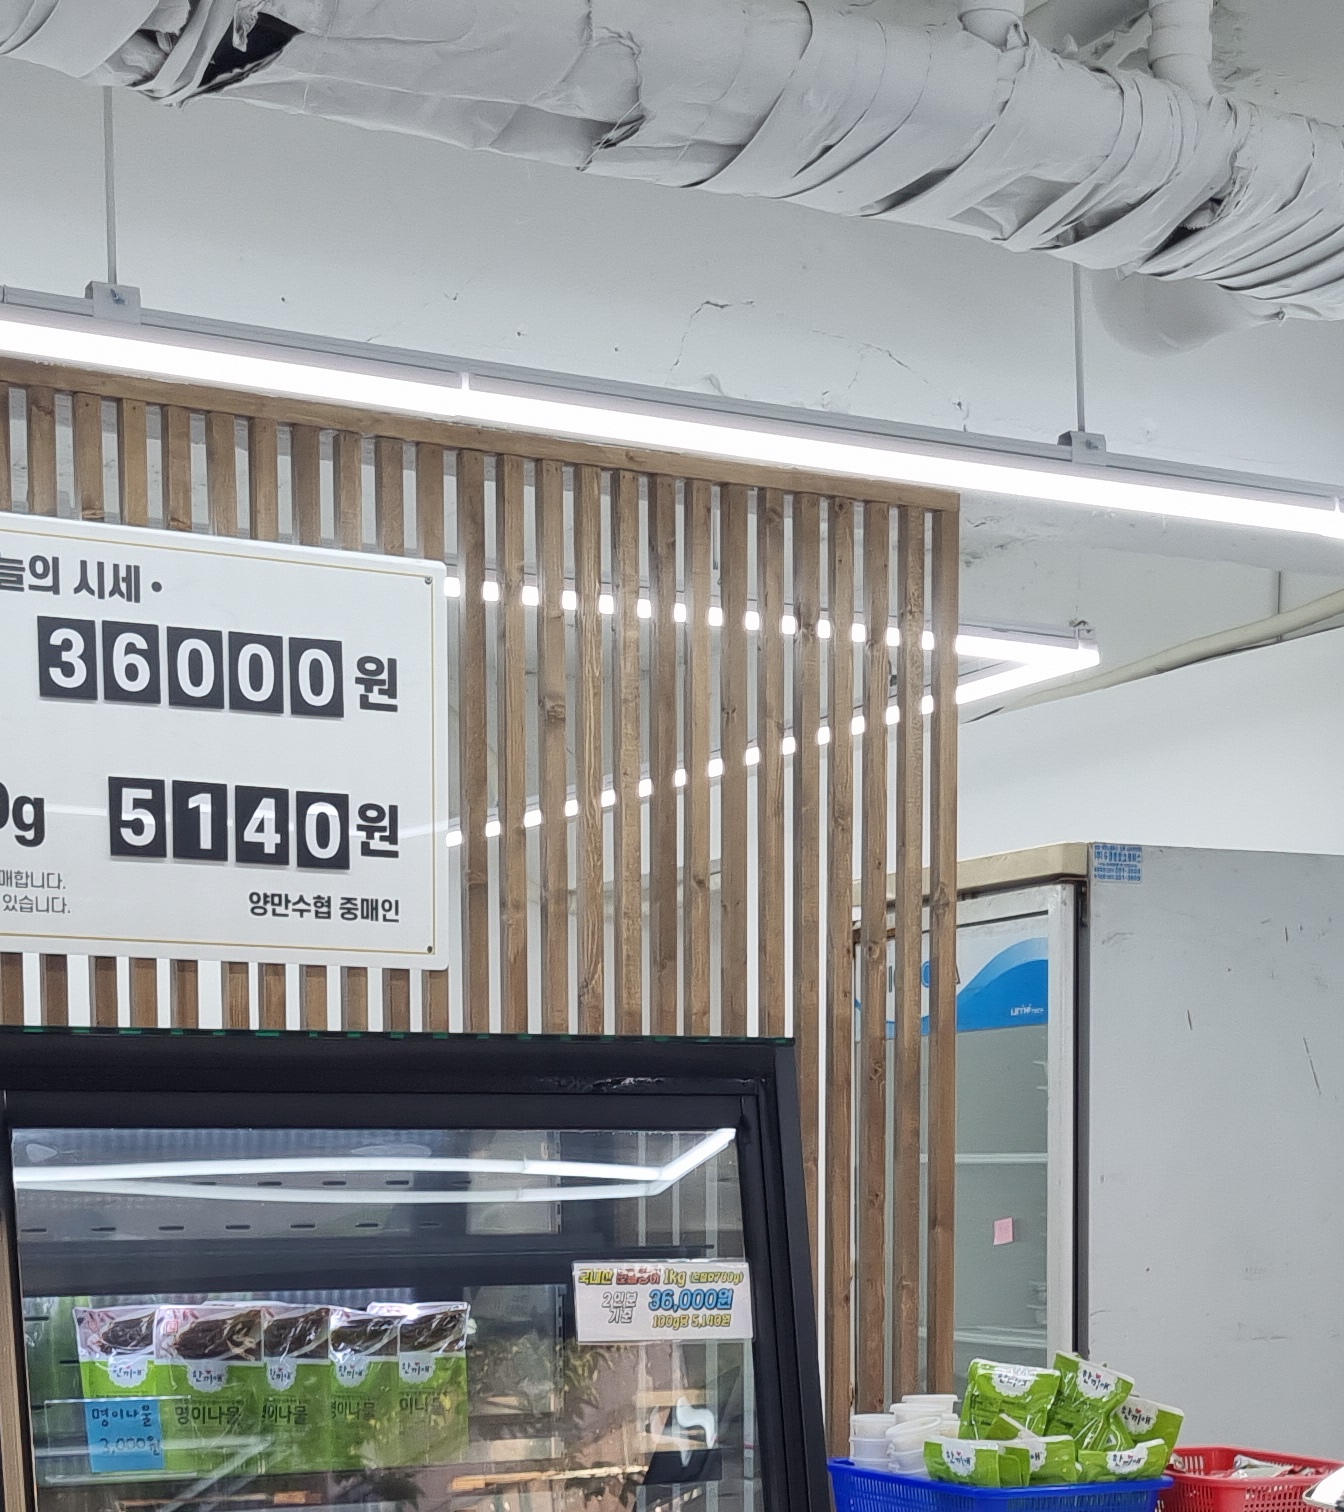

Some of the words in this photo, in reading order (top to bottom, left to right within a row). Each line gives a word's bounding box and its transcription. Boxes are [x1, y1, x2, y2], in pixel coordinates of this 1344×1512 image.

[73, 560, 142, 604] 시세
[2, 893, 70, 914] 있습니다.
[248, 891, 332, 921] 양만수협
[338, 896, 400, 923] 중매인
[663, 1268, 687, 1287] 1kg
[601, 1291, 638, 1308] 2인분
[648, 1288, 734, 1313] 36,000원
[608, 1307, 633, 1324] 기준
[92, 1404, 153, 1427] 명이나물
[174, 1404, 241, 1426] 명이나물
